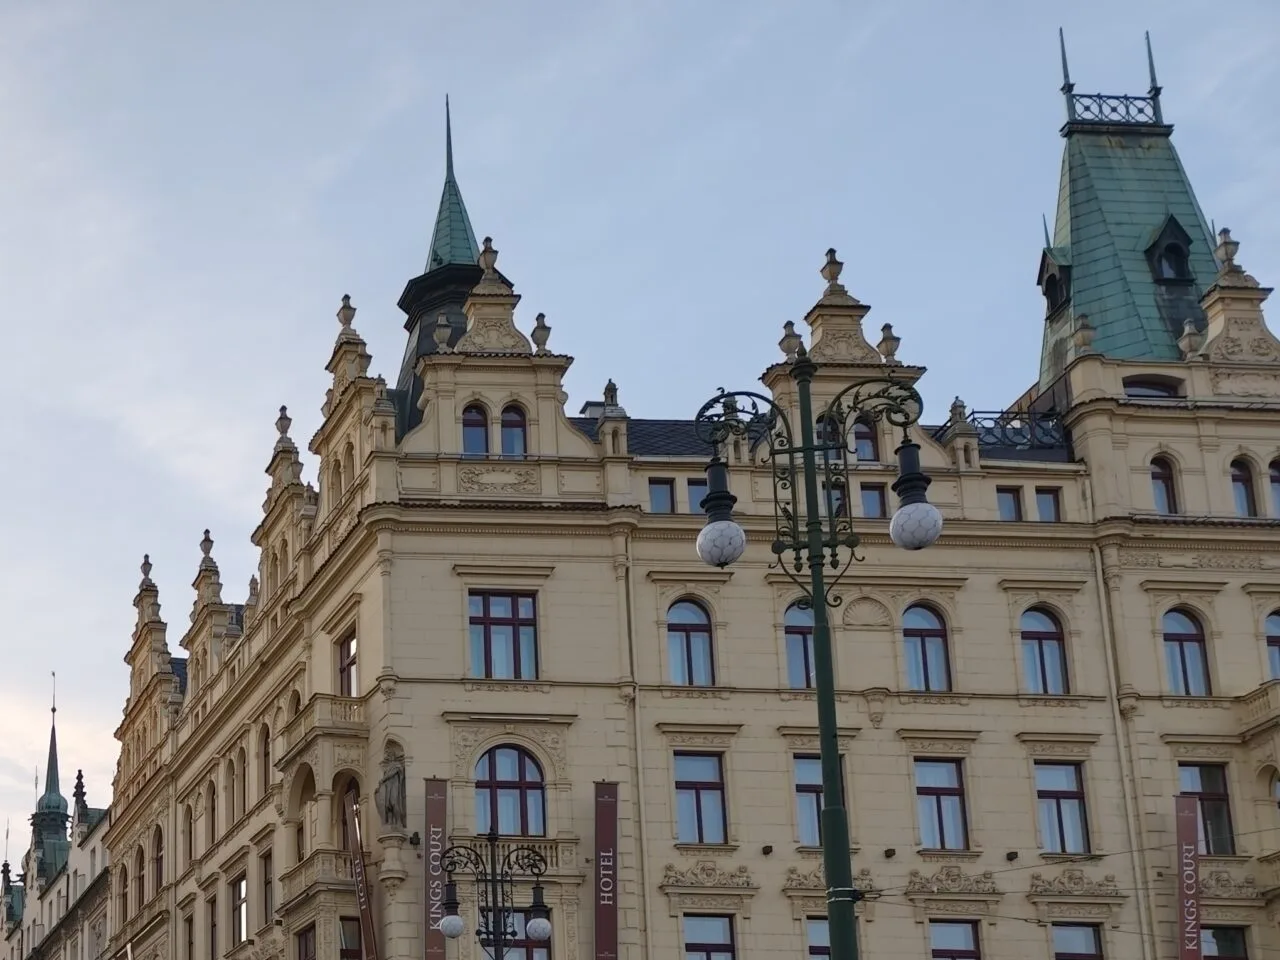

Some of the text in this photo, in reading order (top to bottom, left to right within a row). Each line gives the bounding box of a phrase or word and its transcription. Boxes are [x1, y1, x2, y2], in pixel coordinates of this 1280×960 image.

[430, 824, 443, 931] KINGS COURT
[600, 848, 613, 905] HOTEL
[1183, 844, 1197, 950] KINGS COURT
